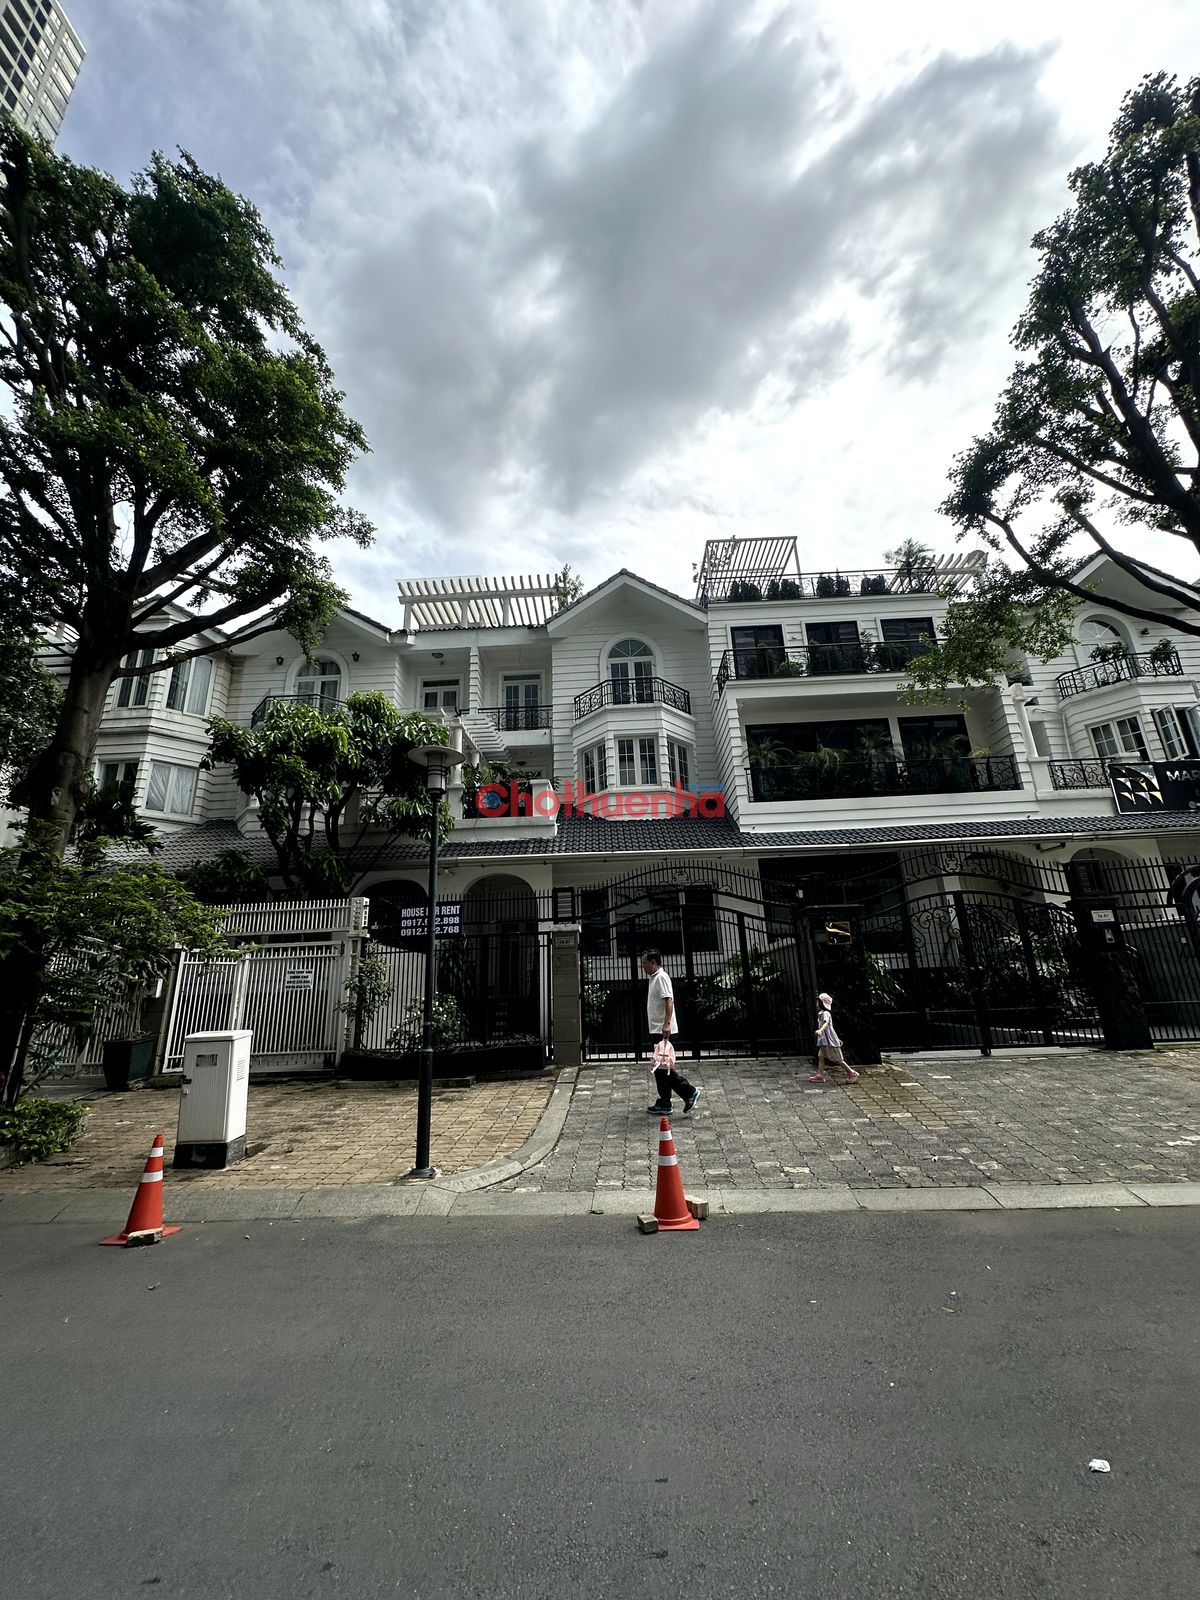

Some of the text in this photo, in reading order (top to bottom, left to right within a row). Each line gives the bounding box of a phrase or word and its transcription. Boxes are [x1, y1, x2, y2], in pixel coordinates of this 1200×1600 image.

[401, 905, 461, 918] HOUSE FR RENT
[401, 916, 460, 927] 0917.2.898
[400, 925, 460, 937] 0912.2.768
